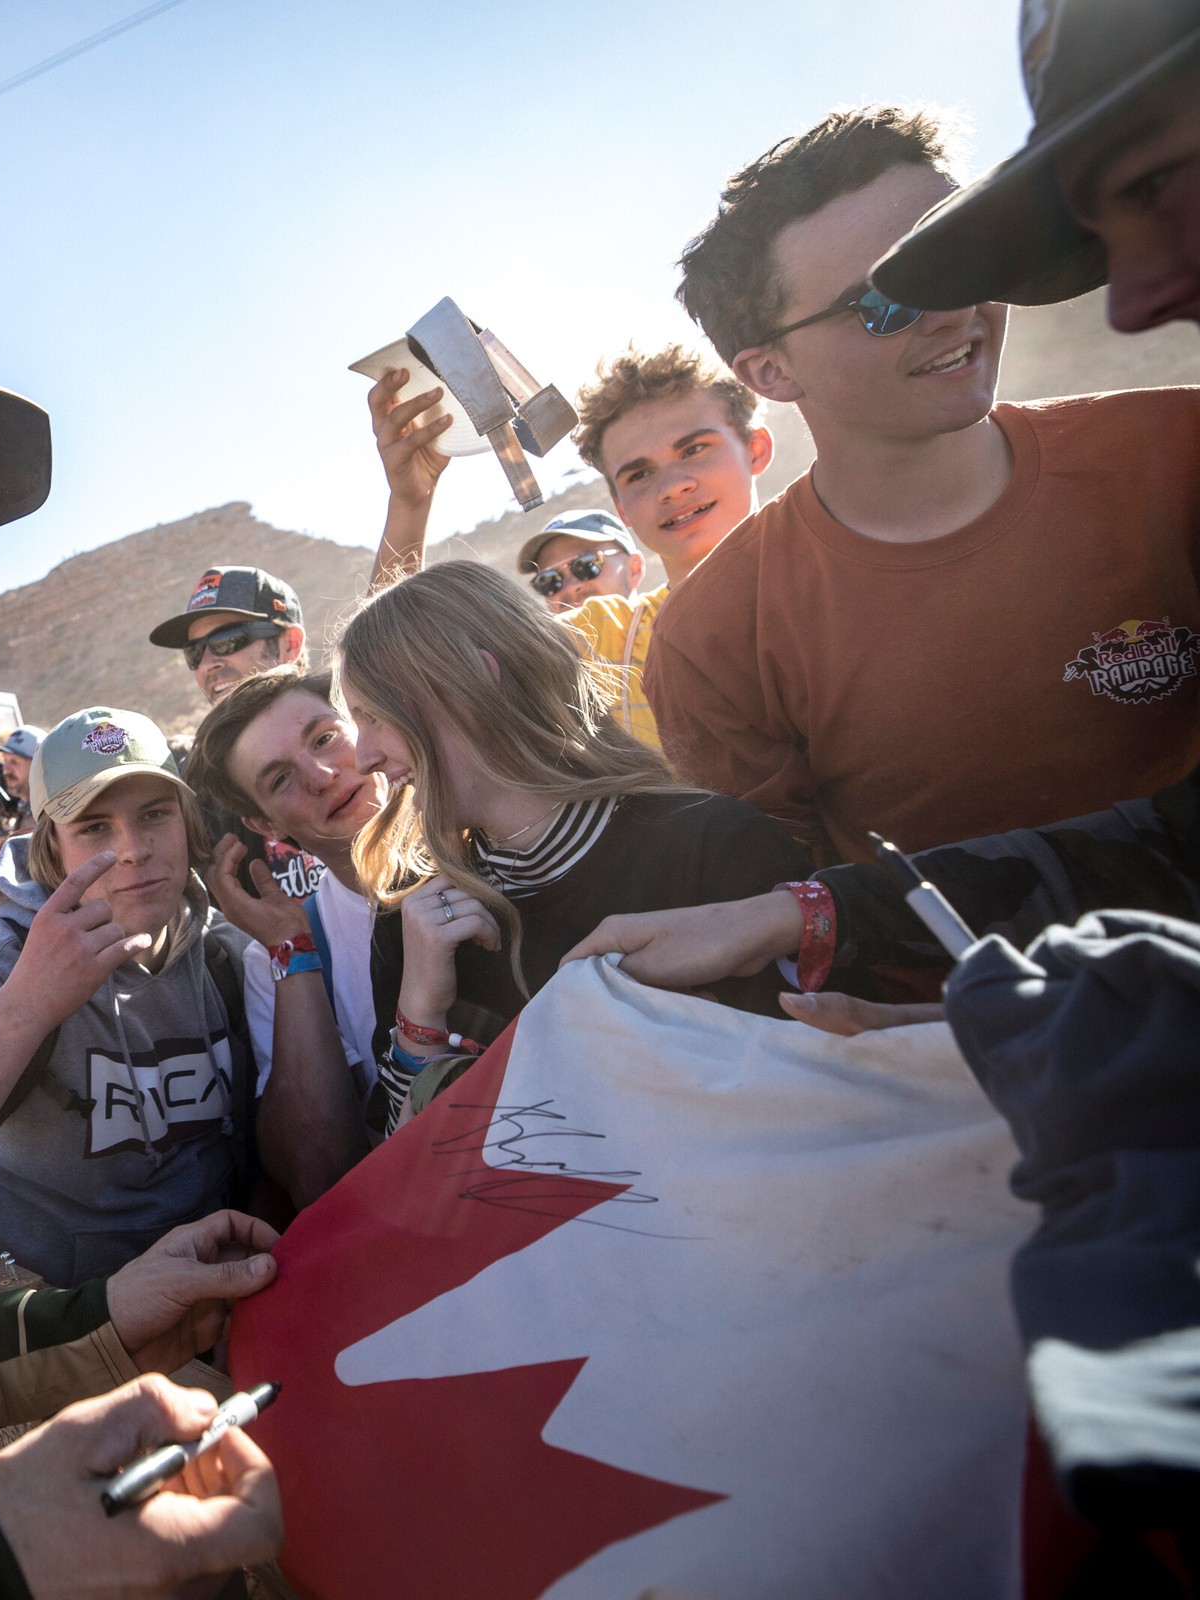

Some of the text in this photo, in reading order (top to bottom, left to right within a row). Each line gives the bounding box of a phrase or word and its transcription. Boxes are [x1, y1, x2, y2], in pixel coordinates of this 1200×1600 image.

[1097, 636, 1178, 666] Red Bull
[1090, 651, 1194, 693] RAMPAGE
